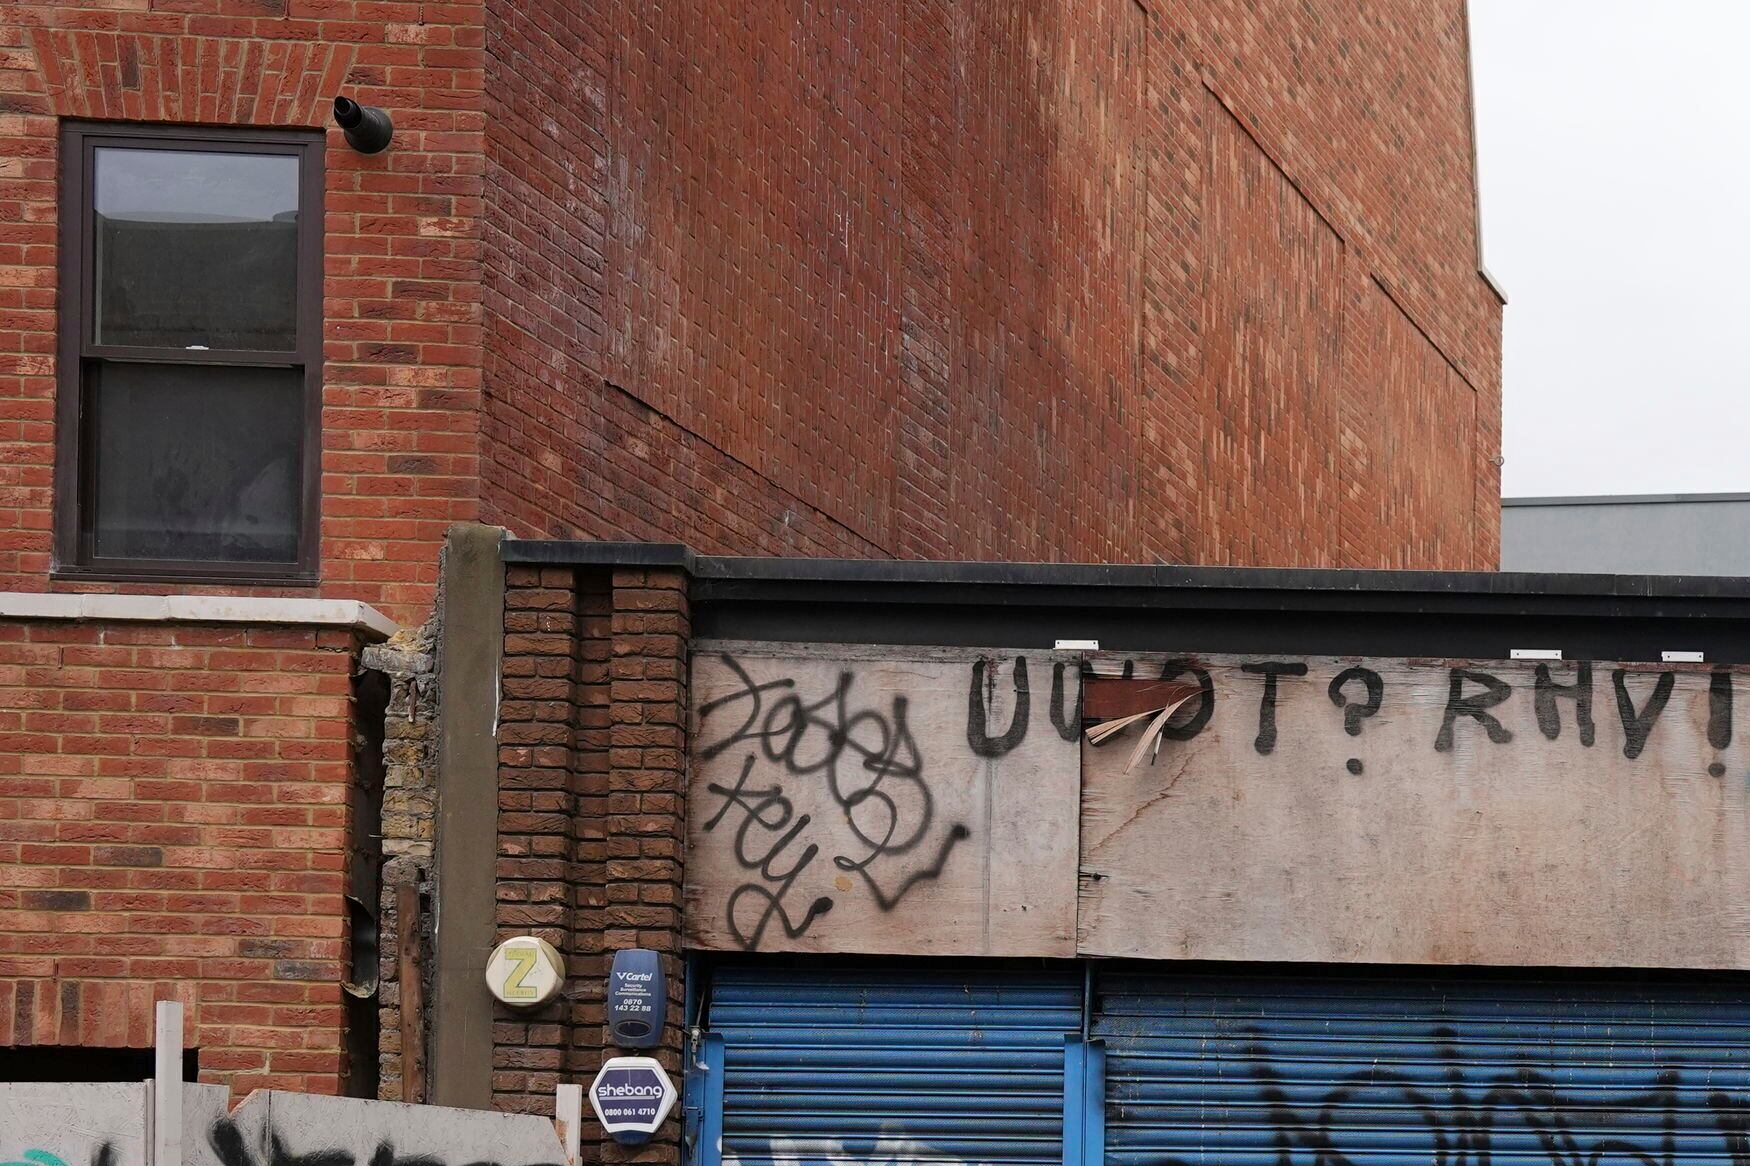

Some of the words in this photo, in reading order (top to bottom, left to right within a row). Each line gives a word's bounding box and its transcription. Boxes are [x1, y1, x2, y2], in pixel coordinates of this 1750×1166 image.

[598, 1083, 663, 1098] shebang
[604, 1108, 622, 1117] 0800
[623, 1108, 636, 1117] 061
[637, 1108, 656, 1116] 4710
